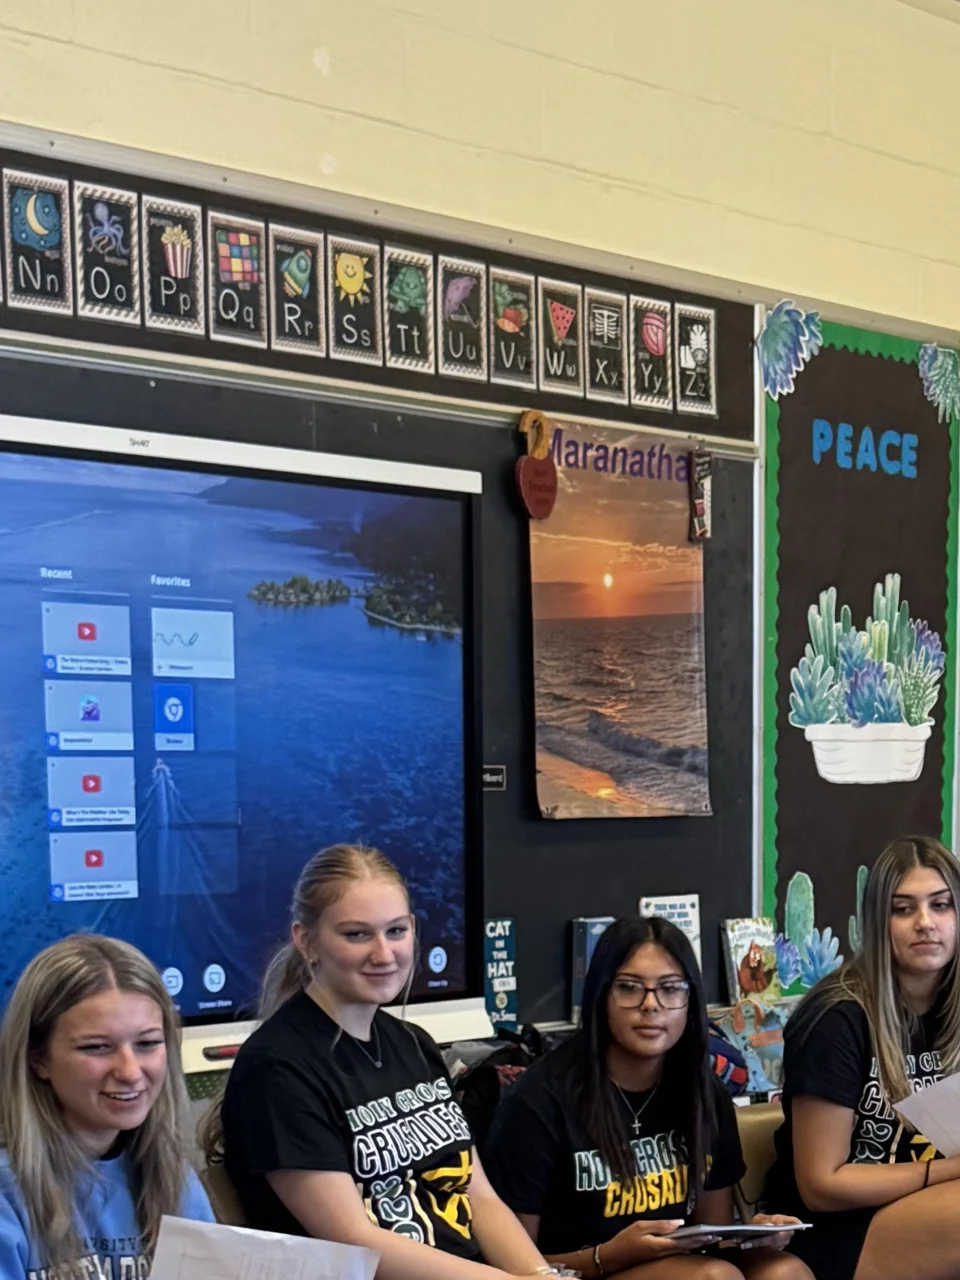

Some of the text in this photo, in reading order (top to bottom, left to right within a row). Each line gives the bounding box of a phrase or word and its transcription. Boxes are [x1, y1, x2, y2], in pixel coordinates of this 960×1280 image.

[812, 418, 919, 479] PEACE
[40, 567, 73, 580] Recent
[151, 574, 191, 587] Favorites
[485, 920, 512, 938] CAT
[495, 939, 505, 949] IN
[492, 950, 508, 960] THE
[487, 961, 515, 978] HAT
